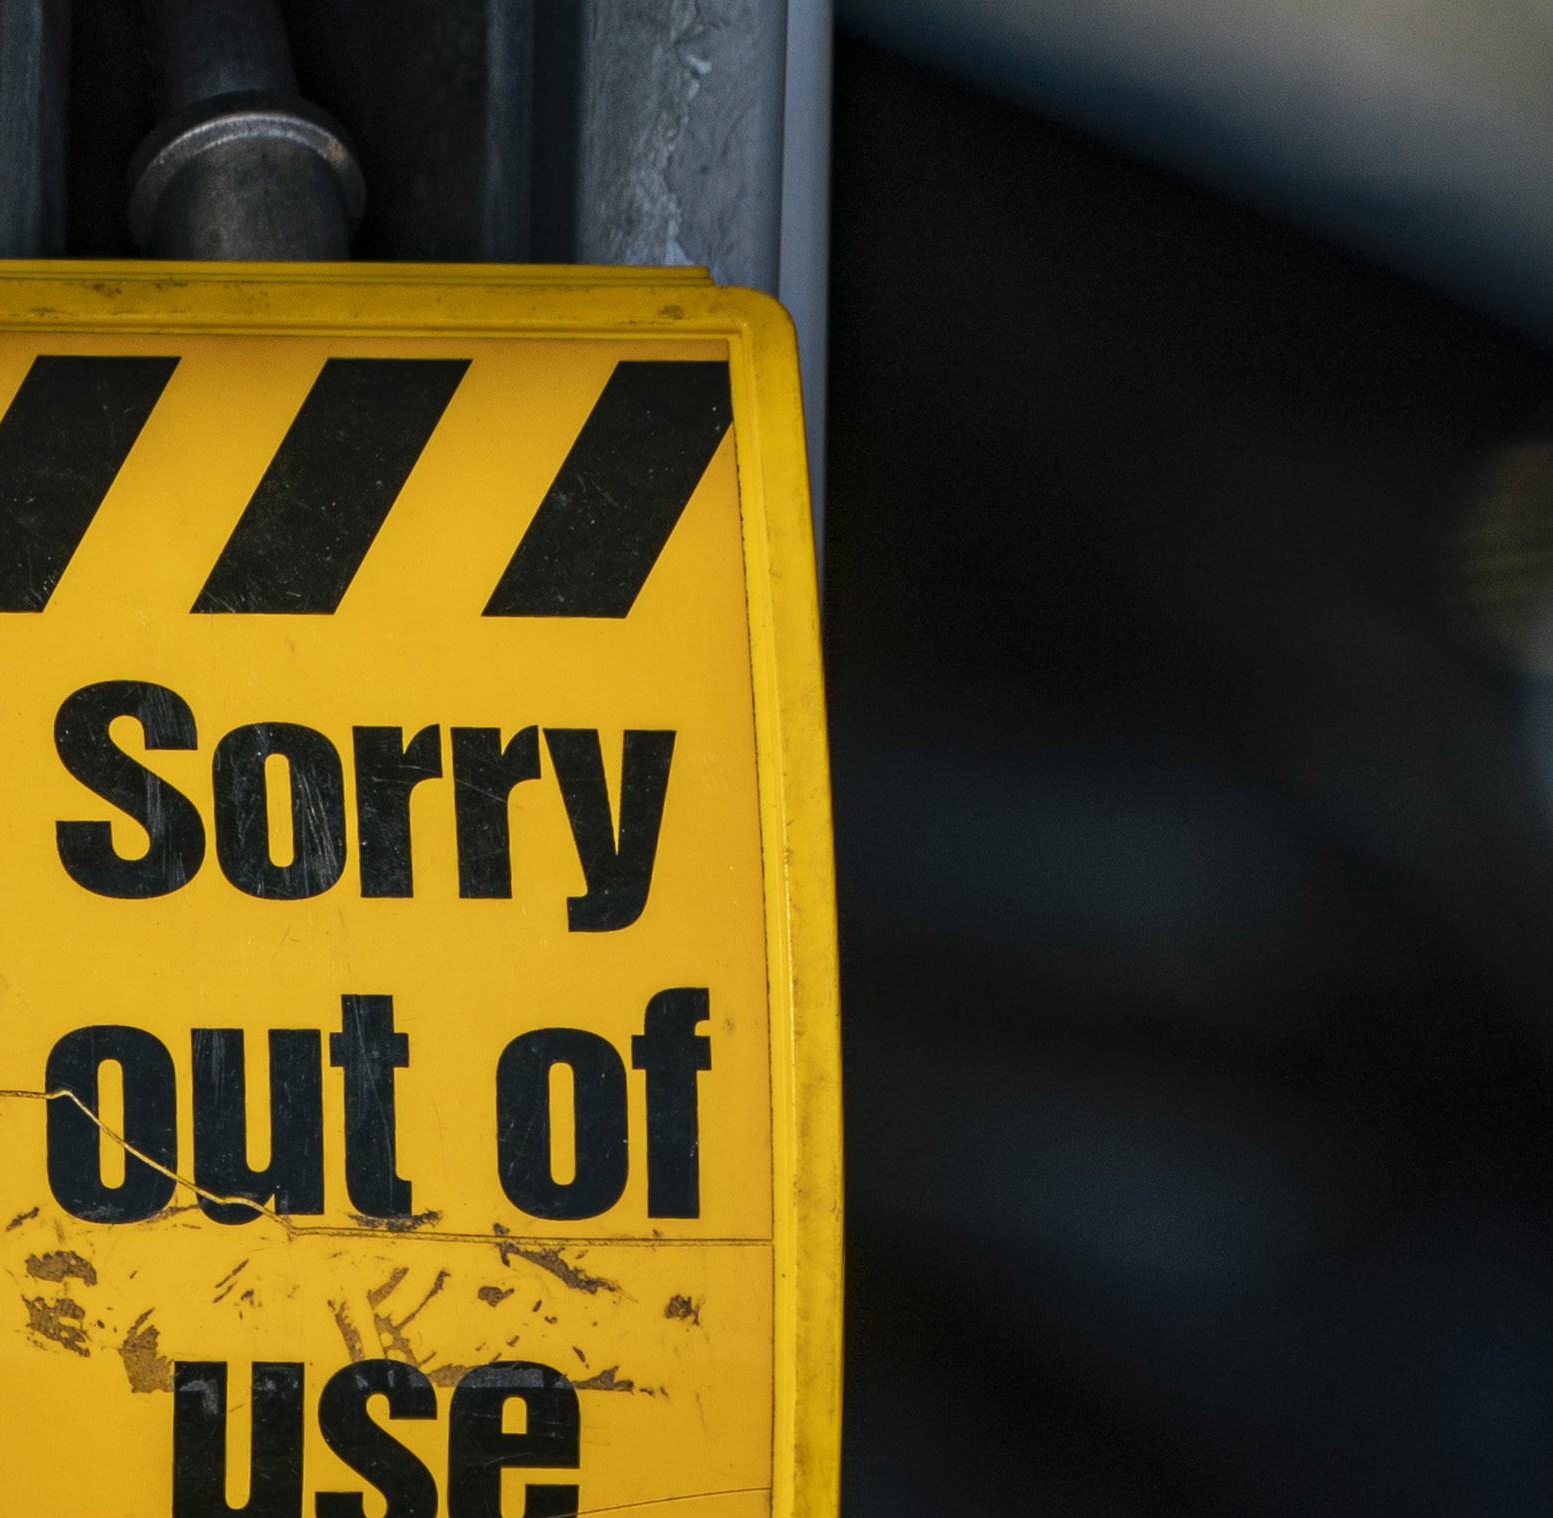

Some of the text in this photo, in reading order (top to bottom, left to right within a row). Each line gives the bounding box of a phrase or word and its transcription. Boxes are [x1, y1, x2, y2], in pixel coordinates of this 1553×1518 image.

[53, 679, 677, 934] Sorry
[44, 987, 712, 1228] out of
